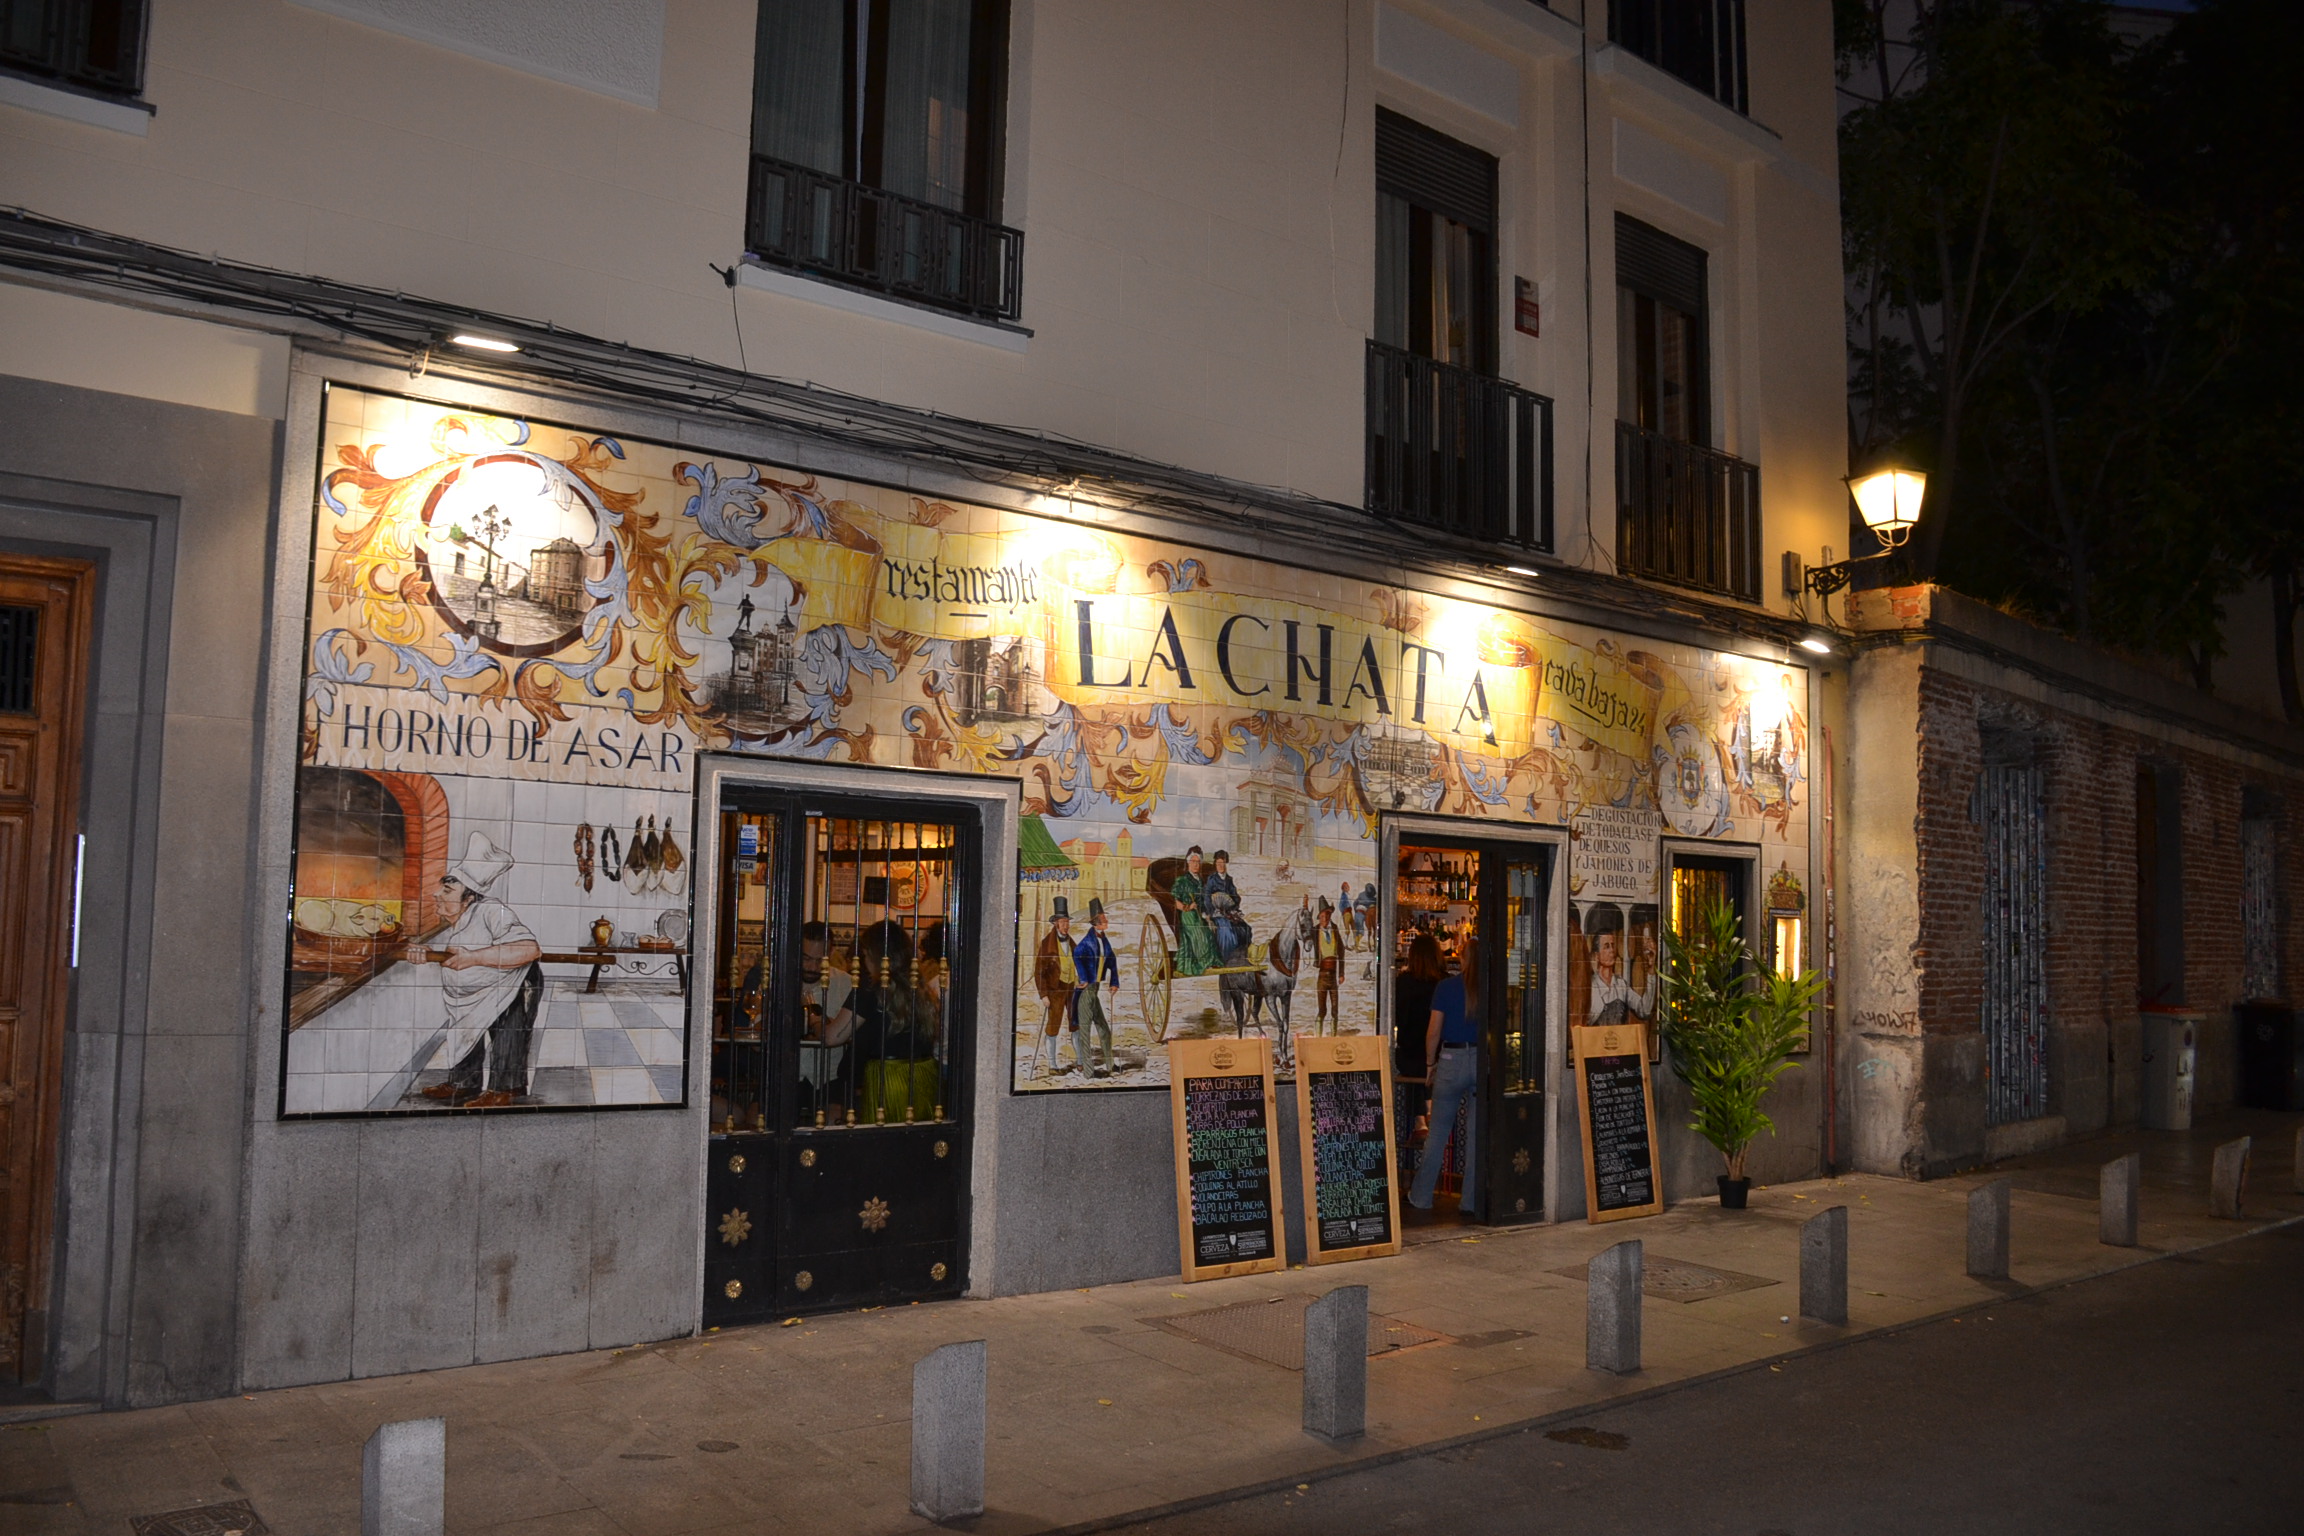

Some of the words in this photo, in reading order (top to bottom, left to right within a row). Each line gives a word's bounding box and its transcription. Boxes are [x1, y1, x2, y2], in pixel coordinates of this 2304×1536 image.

[1073, 600, 1196, 689] LA
[1216, 614, 1499, 748] CHATA
[343, 703, 492, 760] HORNO
[508, 718, 550, 764] DE
[561, 726, 684, 774] ASAR
[1582, 822, 1595, 836] DE
[1596, 824, 1621, 839] TODA
[1621, 826, 1653, 842] CLASE
[1579, 838, 1591, 852] DE
[1593, 839, 1631, 855] QUESOS
[1574, 855, 1581, 868] Y
[1583, 855, 1634, 872] JAMONES
[1638, 860, 1652, 873] DE
[1189, 1079, 1214, 1091] PARA
[1215, 1077, 1259, 1090] COMPARTIR
[1189, 1091, 1232, 1103] TORREZNOS
[1233, 1090, 1242, 1100] DE
[1230, 1109, 1258, 1119] PLANCHA
[1215, 1121, 1225, 1129] DE
[1226, 1120, 1247, 1128] POLLO
[1239, 1128, 1267, 1137] PLANCHA
[1237, 1138, 1248, 1147] CON
[1249, 1137, 1266, 1147] MIEL
[1223, 1149, 1231, 1159] DE
[1254, 1147, 1266, 1156] CON
[1238, 1168, 1269, 1178] PLANCHA
[1226, 1182, 1236, 1190] AL
[1234, 1200, 1265, 1210] PLANCHA
[1200, 1243, 1230, 1254] CERVEZA
